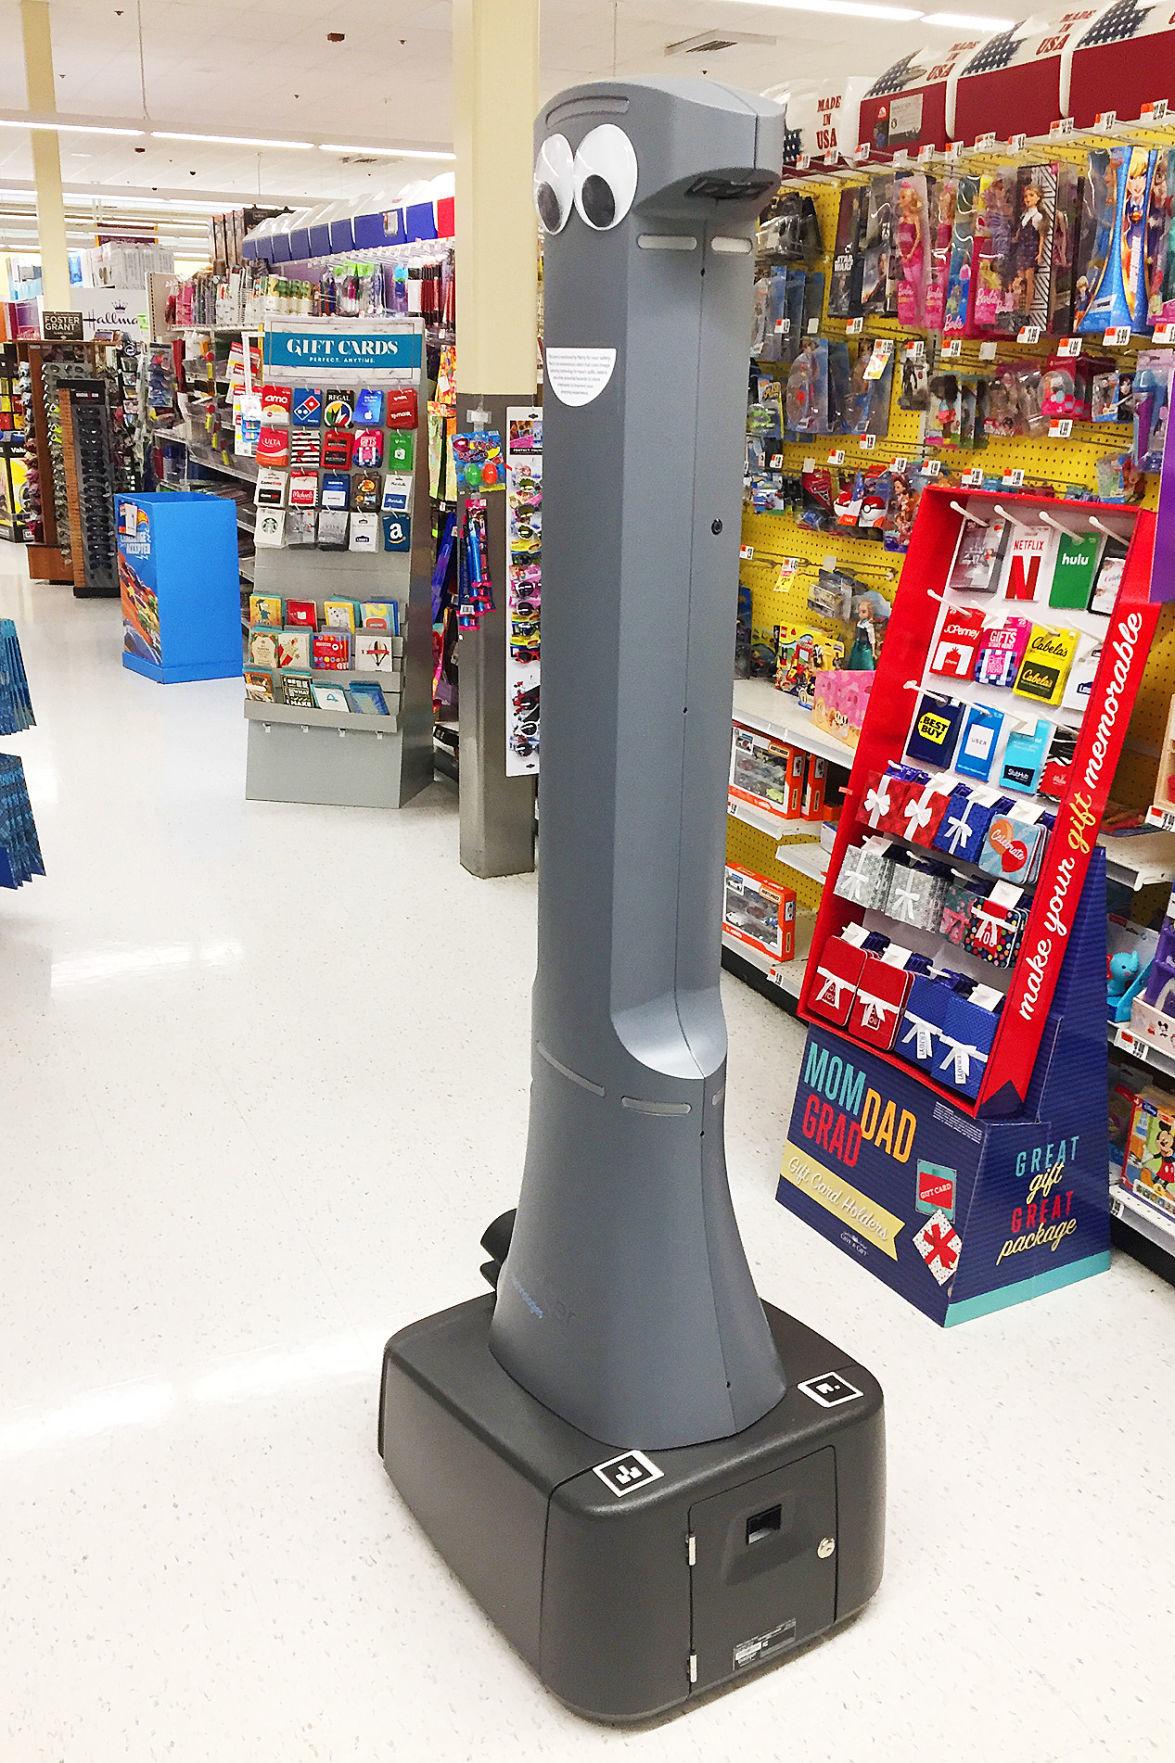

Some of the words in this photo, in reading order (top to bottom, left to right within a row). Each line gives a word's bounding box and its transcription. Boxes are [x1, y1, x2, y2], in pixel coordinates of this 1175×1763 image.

[1062, 10, 1097, 21] MADE
[1036, 34, 1070, 55] USA
[927, 63, 955, 81] USA
[817, 95, 841, 112] MADE
[823, 113, 831, 126] IN
[816, 128, 837, 150] USA
[45, 315, 80, 324] FOSTER
[45, 323, 75, 331] GRANT
[287, 338, 334, 357] GIFT
[338, 340, 398, 355] CARDS
[264, 438, 281, 447] ULTA
[1013, 540, 1044, 551] NETFLIX
[1061, 553, 1089, 566] hulu
[1005, 555, 1041, 601] N
[944, 624, 980, 640] JCPenney
[990, 630, 1017, 644] GIFTS
[1031, 636, 1068, 657] Cabela's
[921, 723, 943, 739] BUY
[922, 716, 948, 731] BEST
[1019, 938, 1052, 1020] make
[1044, 856, 1075, 937] your
[1067, 791, 1097, 855] gift
[1084, 611, 1143, 789] memorable
[803, 1042, 867, 1116] MOM
[802, 1094, 863, 1168] GRAD
[860, 1087, 917, 1164] DAD
[1015, 1135, 1080, 1177] GREAT
[921, 1188, 934, 1199] GIFT
[935, 1182, 952, 1194] CARD
[1025, 1161, 1064, 1204] gift
[788, 1155, 810, 1184] Gift
[808, 1169, 841, 1204] Card
[841, 1193, 889, 1242] Holders
[1011, 1190, 1074, 1234] GREAT
[996, 1217, 1077, 1266] package
